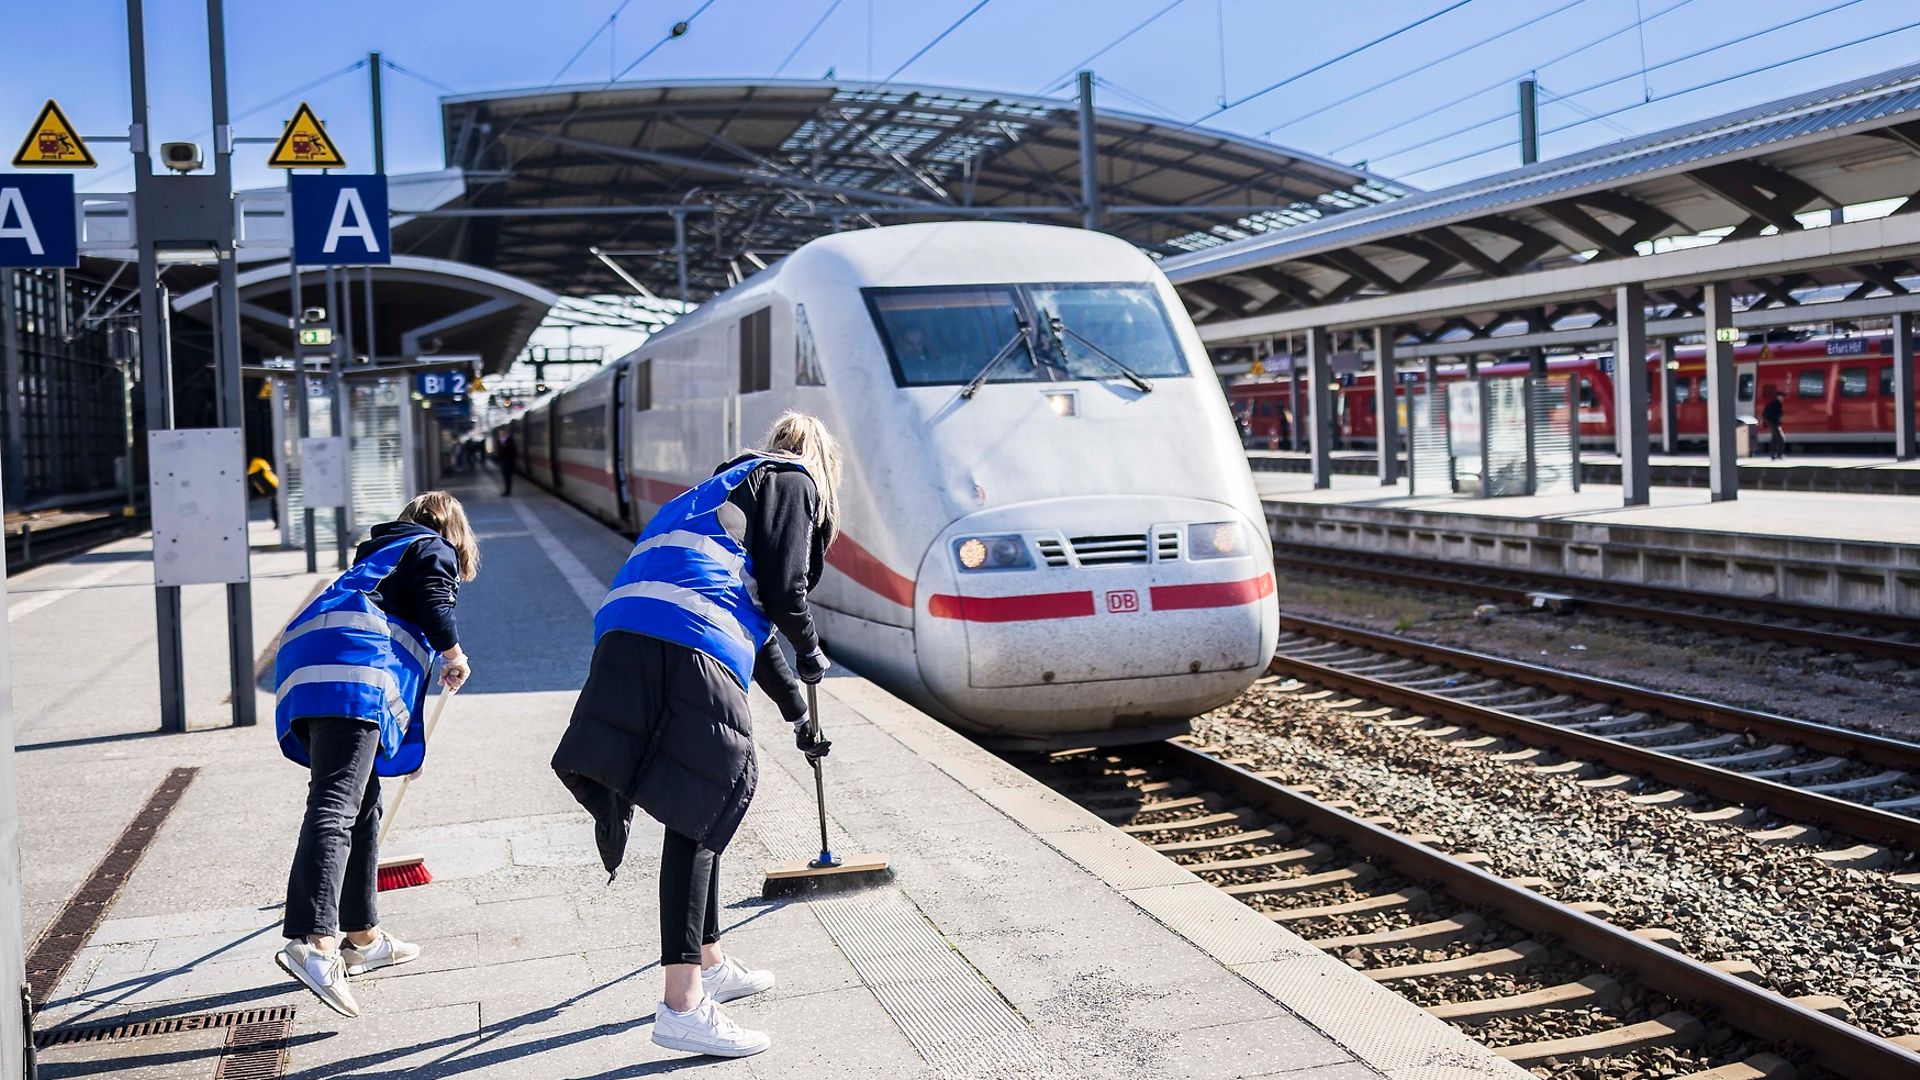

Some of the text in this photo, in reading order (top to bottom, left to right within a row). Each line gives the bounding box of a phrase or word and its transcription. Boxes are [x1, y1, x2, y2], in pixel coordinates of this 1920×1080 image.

[0, 187, 45, 255] A
[322, 187, 380, 254] A
[452, 374, 466, 394] 2
[1110, 593, 1135, 610] DB
